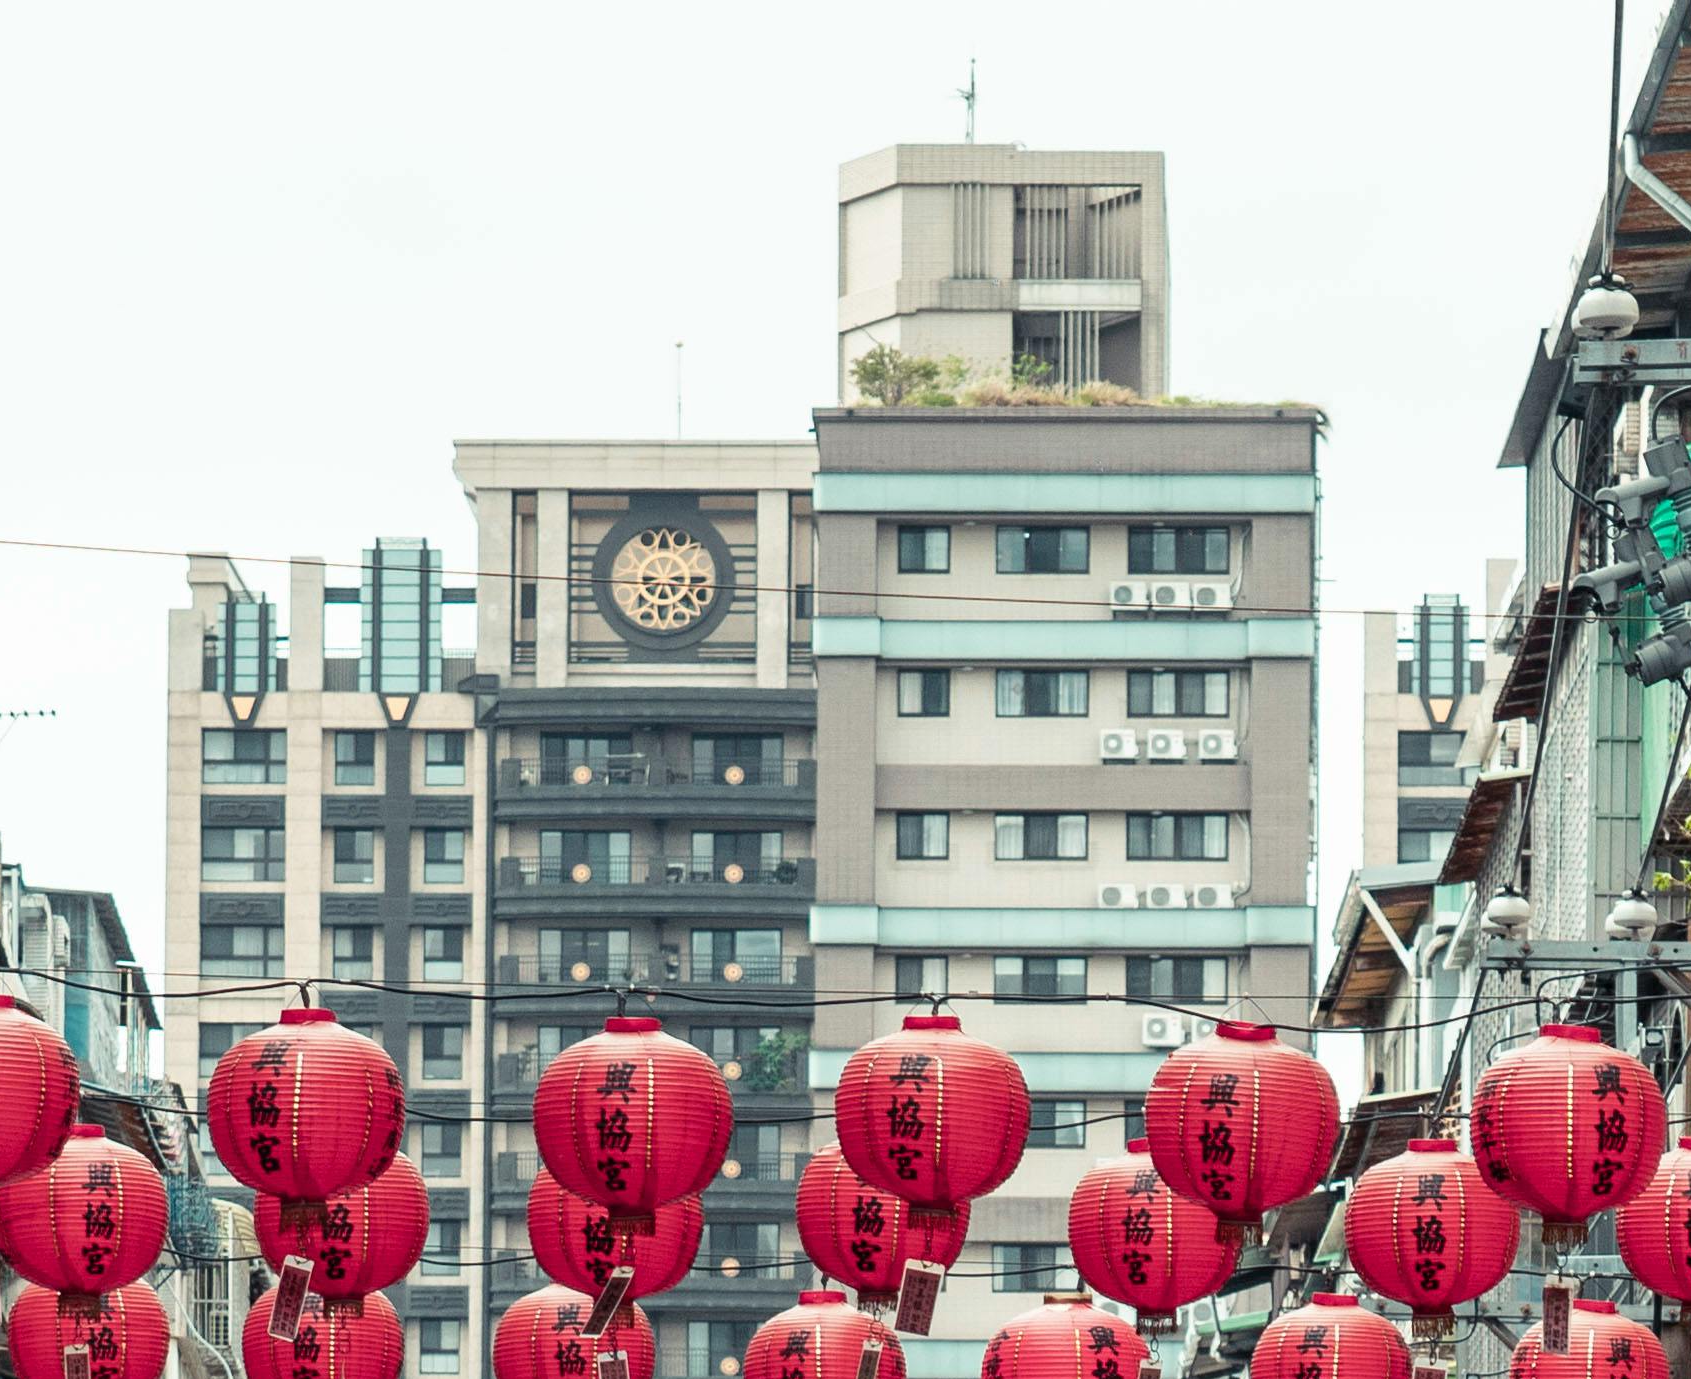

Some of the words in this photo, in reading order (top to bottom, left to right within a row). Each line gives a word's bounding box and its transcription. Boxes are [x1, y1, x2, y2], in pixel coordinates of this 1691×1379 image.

[246, 1042, 290, 1174] 興協宮
[596, 1062, 637, 1192] 興協宮
[885, 1054, 933, 1180] 興協宮
[1198, 1073, 1240, 1202] 興協宮
[1592, 1064, 1628, 1195] 興協宮
[82, 1162, 116, 1277] 興協宮
[320, 1188, 353, 1281] 協宮
[583, 1210, 616, 1284] 協宮
[850, 1192, 886, 1274] 協宮
[1121, 1170, 1161, 1285] 興協宮
[1413, 1173, 1449, 1291] 興協宮
